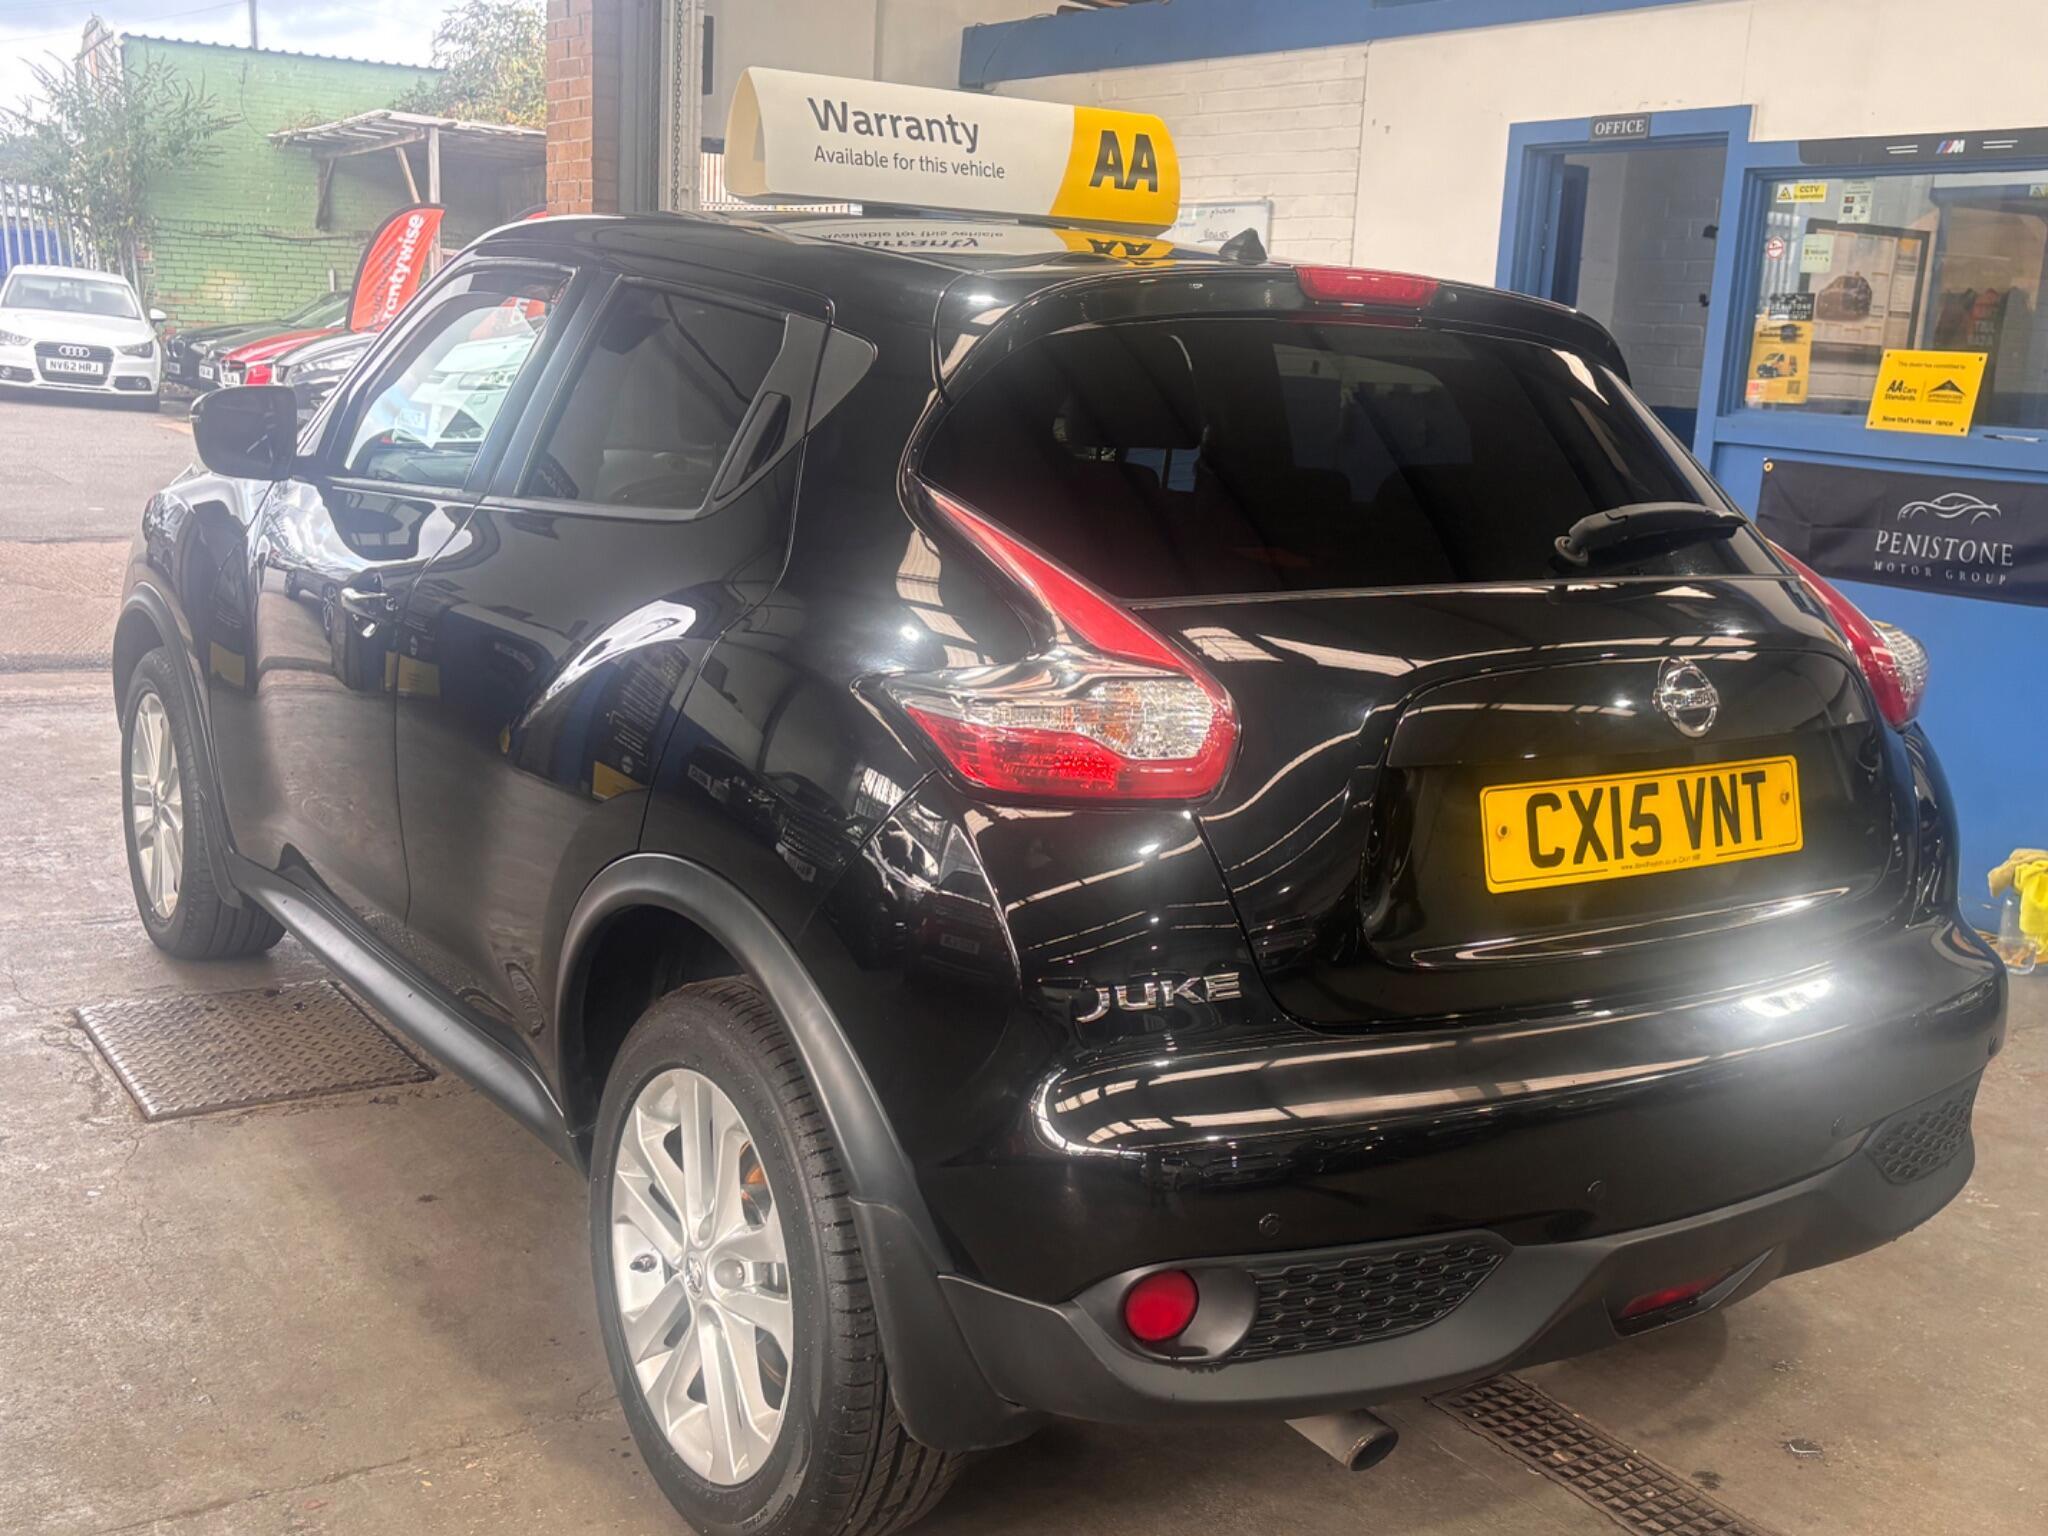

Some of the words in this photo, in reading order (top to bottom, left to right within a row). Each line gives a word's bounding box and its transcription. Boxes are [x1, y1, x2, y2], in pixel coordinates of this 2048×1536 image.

[808, 97, 979, 154] Warranty
[1594, 120, 1645, 135] OFFICE
[814, 145, 889, 169] Available
[893, 153, 914, 171] for
[919, 156, 947, 174] this
[951, 160, 1005, 180] vehicle
[1089, 130, 1158, 192] AA
[1799, 184, 1820, 194] CCTV
[49, 360, 77, 371] NV62
[78, 363, 98, 373] HRJ
[1886, 380, 1904, 393] AA
[1875, 529, 2014, 566] PENISTONE
[1873, 560, 1932, 577] MOTOR
[1945, 570, 2007, 585] GROUP
[1526, 782, 1662, 869] CX15
[1677, 770, 1766, 850] VNT
[1076, 972, 1242, 1023] JUKE
